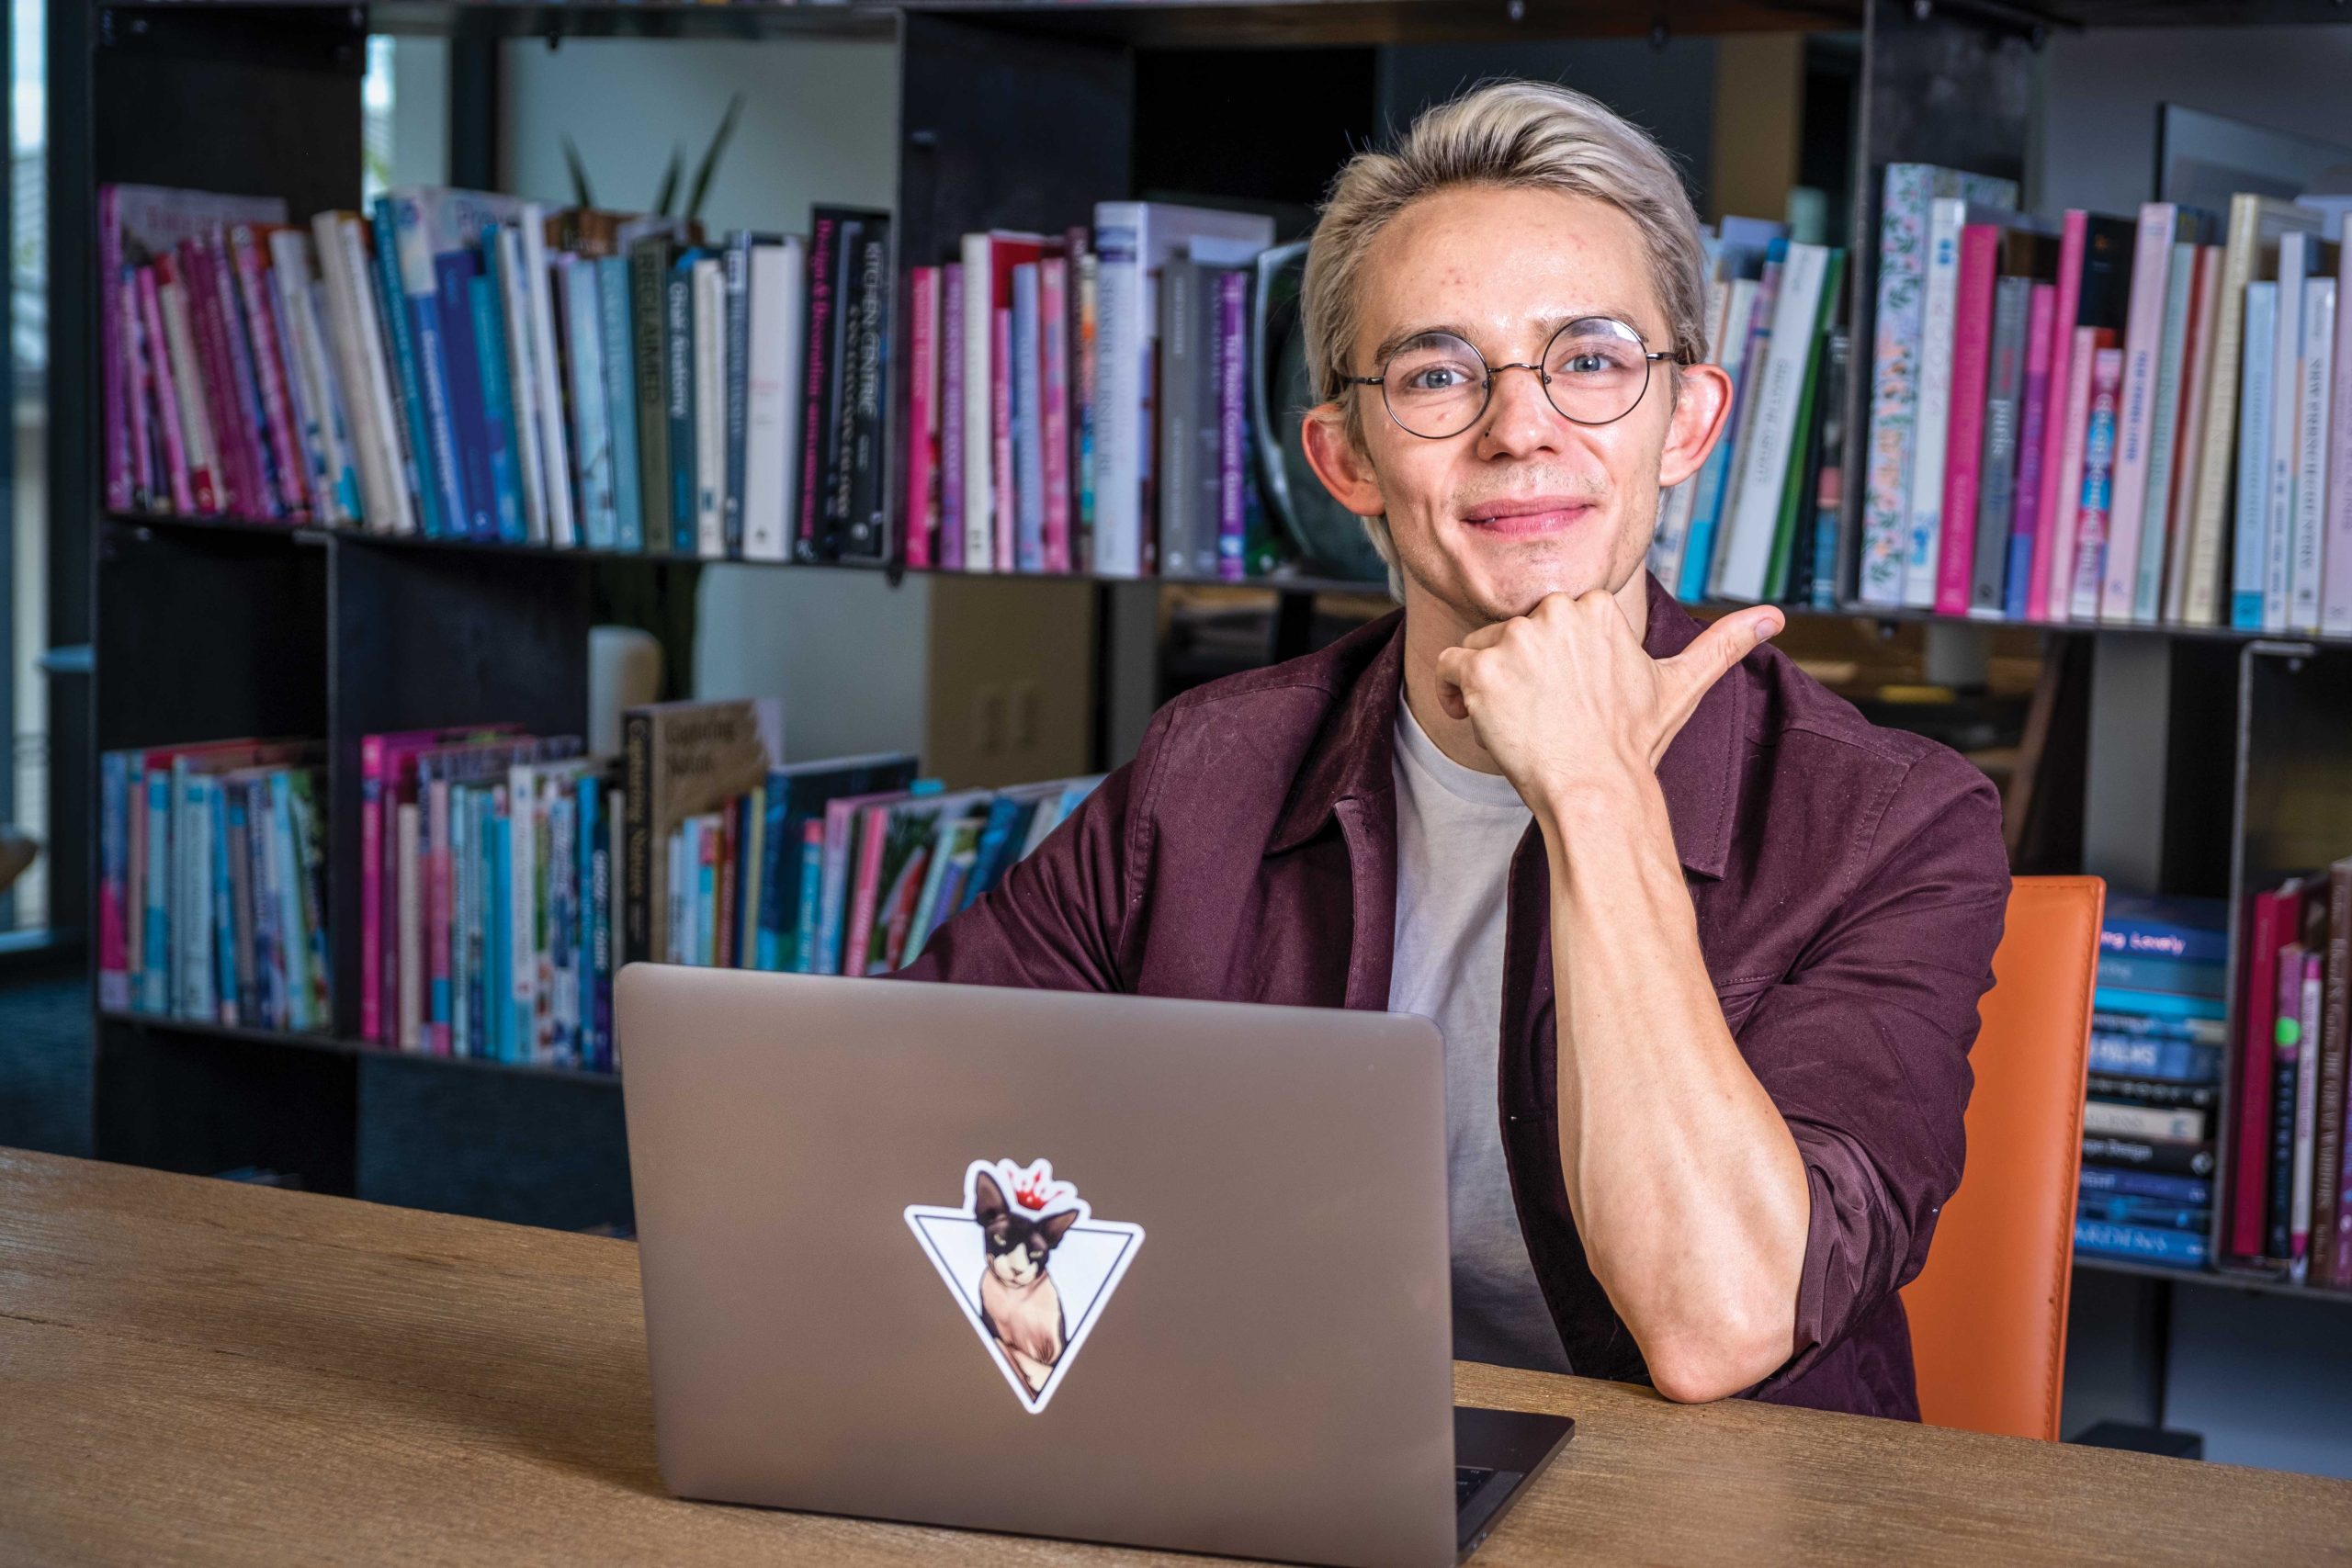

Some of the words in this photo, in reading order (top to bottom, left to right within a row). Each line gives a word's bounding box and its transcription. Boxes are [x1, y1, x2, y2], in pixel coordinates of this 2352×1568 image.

[670, 281, 686, 330] Chair
[862, 242, 883, 325] KITCHEN
[1100, 277, 1114, 355] SHAKER
[638, 253, 663, 404] RECLAIMED
[807, 300, 830, 396] Decoration
[670, 334, 687, 420] Anatomy
[856, 331, 881, 419] CENTRIC
[1099, 362, 1114, 478] FURNITURE
[2130, 931, 2187, 955] Lovely
